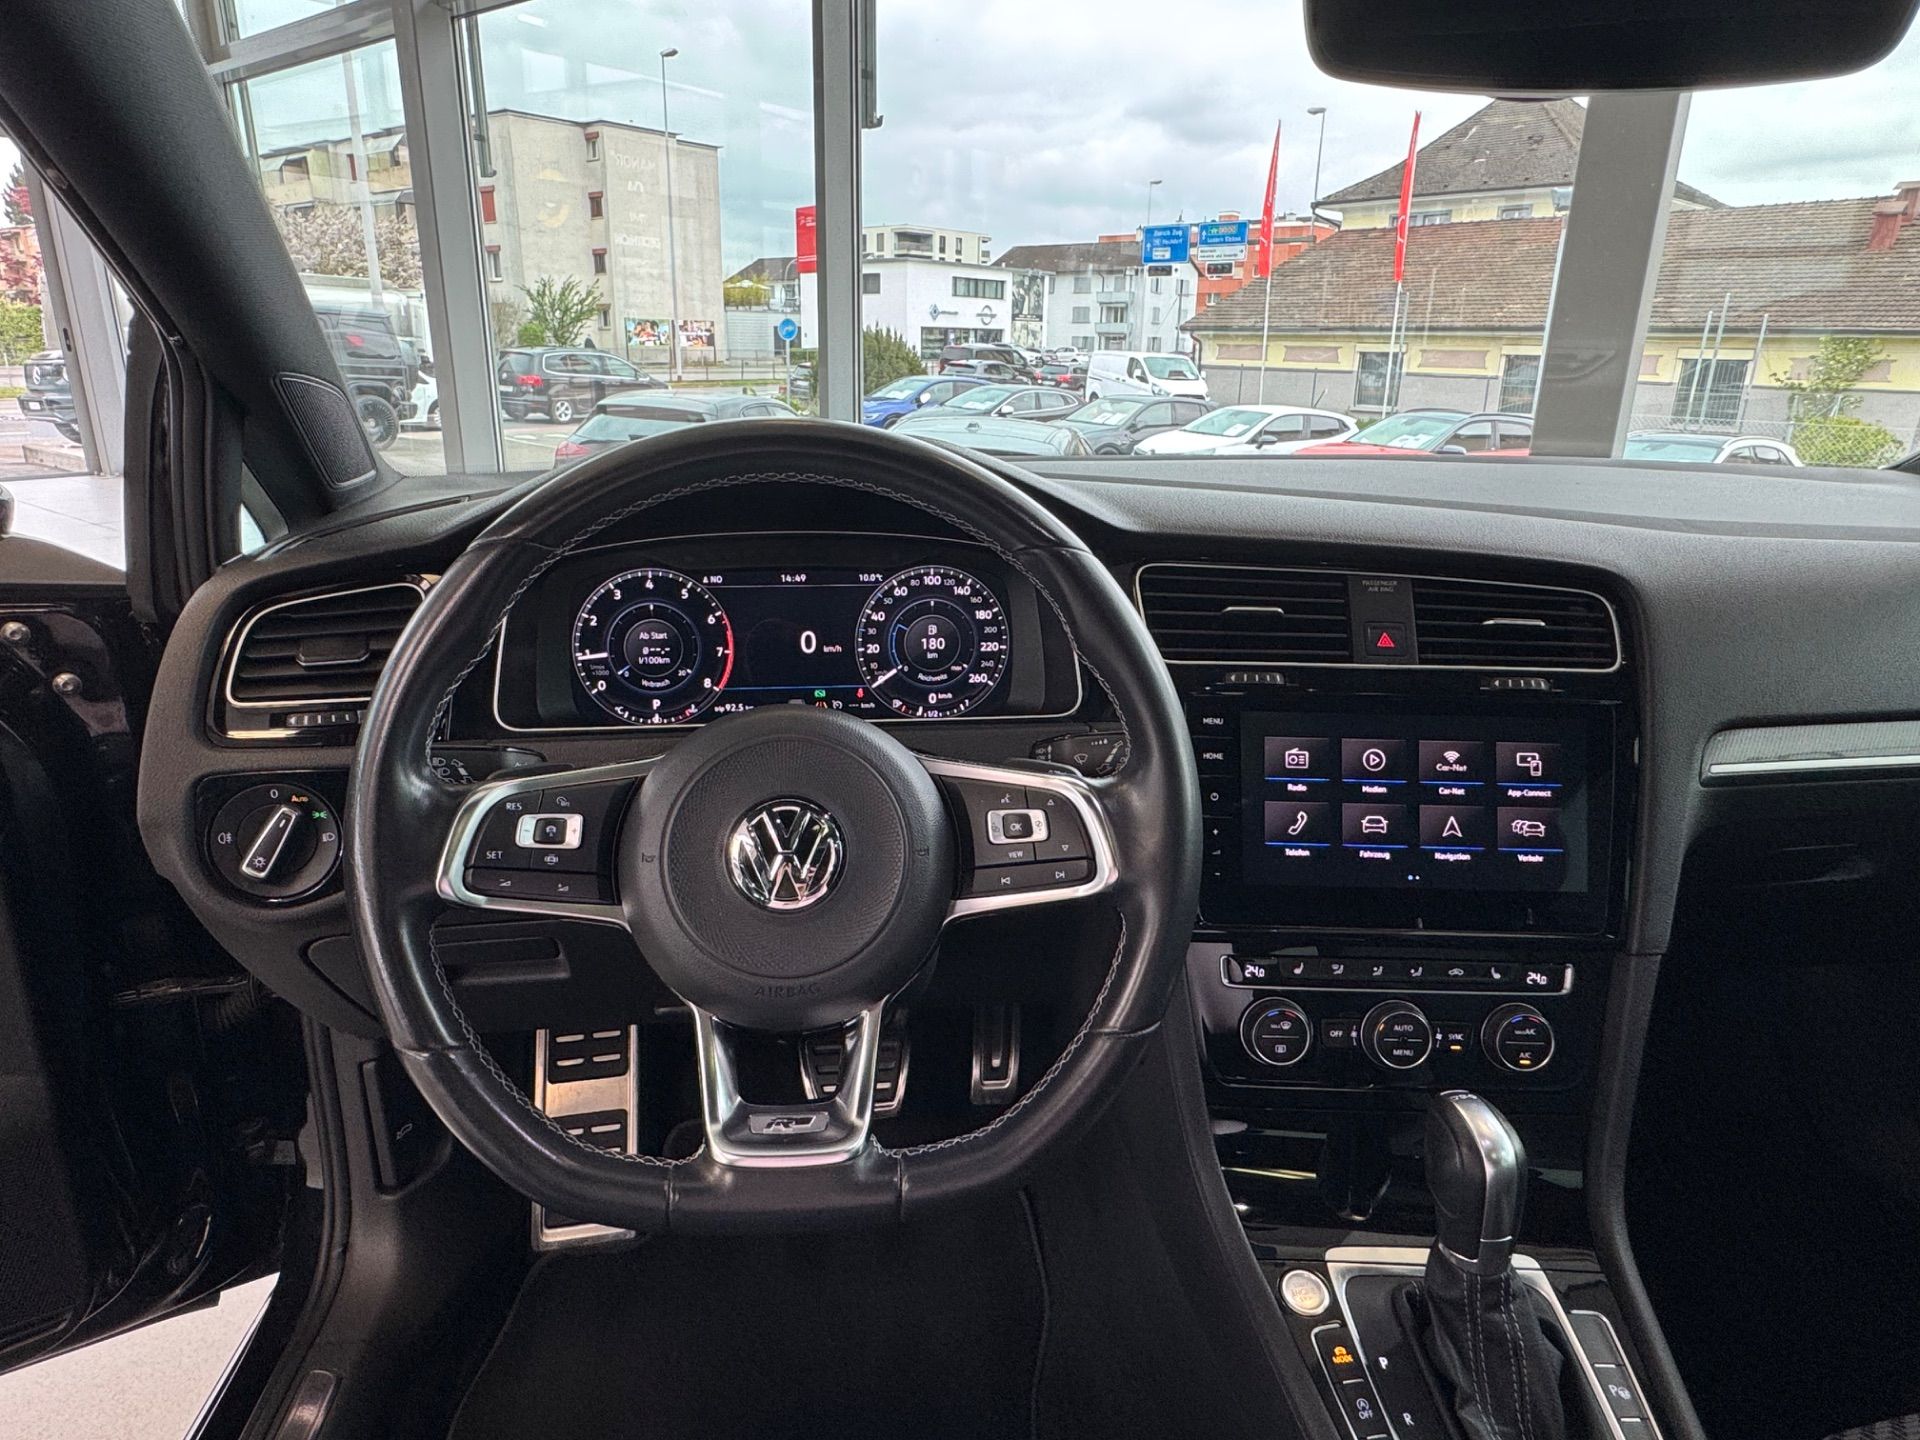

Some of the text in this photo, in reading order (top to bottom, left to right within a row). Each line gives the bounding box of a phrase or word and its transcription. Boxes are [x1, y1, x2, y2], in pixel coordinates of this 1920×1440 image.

[780, 574, 807, 582] 14:49
[923, 576, 941, 585] 100
[645, 581, 654, 589] 4
[614, 590, 622, 600] 3
[681, 589, 689, 599] 5
[894, 586, 908, 596] 60
[953, 586, 971, 596] 140
[883, 597, 893, 605] 50
[707, 614, 715, 624] 6
[871, 611, 885, 621] 40
[975, 610, 992, 620] 180
[590, 616, 597, 626] 2
[984, 626, 997, 634] 200
[639, 632, 668, 640] Ab Start
[800, 631, 842, 654] 0 km/h
[921, 638, 945, 650] 180
[980, 642, 999, 651] 220
[716, 647, 723, 657] 7
[867, 644, 880, 653] 20
[927, 649, 938, 659] km
[980, 660, 994, 668] 240
[968, 673, 987, 683] 260
[598, 680, 606, 691] 0
[704, 678, 712, 688] 8
[928, 693, 937, 704] 0
[652, 699, 661, 710] P
[725, 703, 744, 712] 92.5
[1287, 784, 1307, 792] Radio
[1362, 786, 1387, 794] Medien
[1439, 787, 1465, 796] Car-Net
[1507, 789, 1552, 798] App-Connect
[506, 802, 522, 811] RES
[1009, 823, 1023, 832] OK
[486, 851, 503, 859] SET
[1008, 851, 1024, 859] VIEW
[1285, 849, 1310, 857] Telefon
[1359, 851, 1391, 860] Fahrzeug
[1435, 852, 1471, 861] Navigation
[1393, 1049, 1413, 1057] MENU
[1378, 1356, 1388, 1370] P
[1359, 1409, 1373, 1420] OFF
[1403, 1412, 1414, 1426] R
